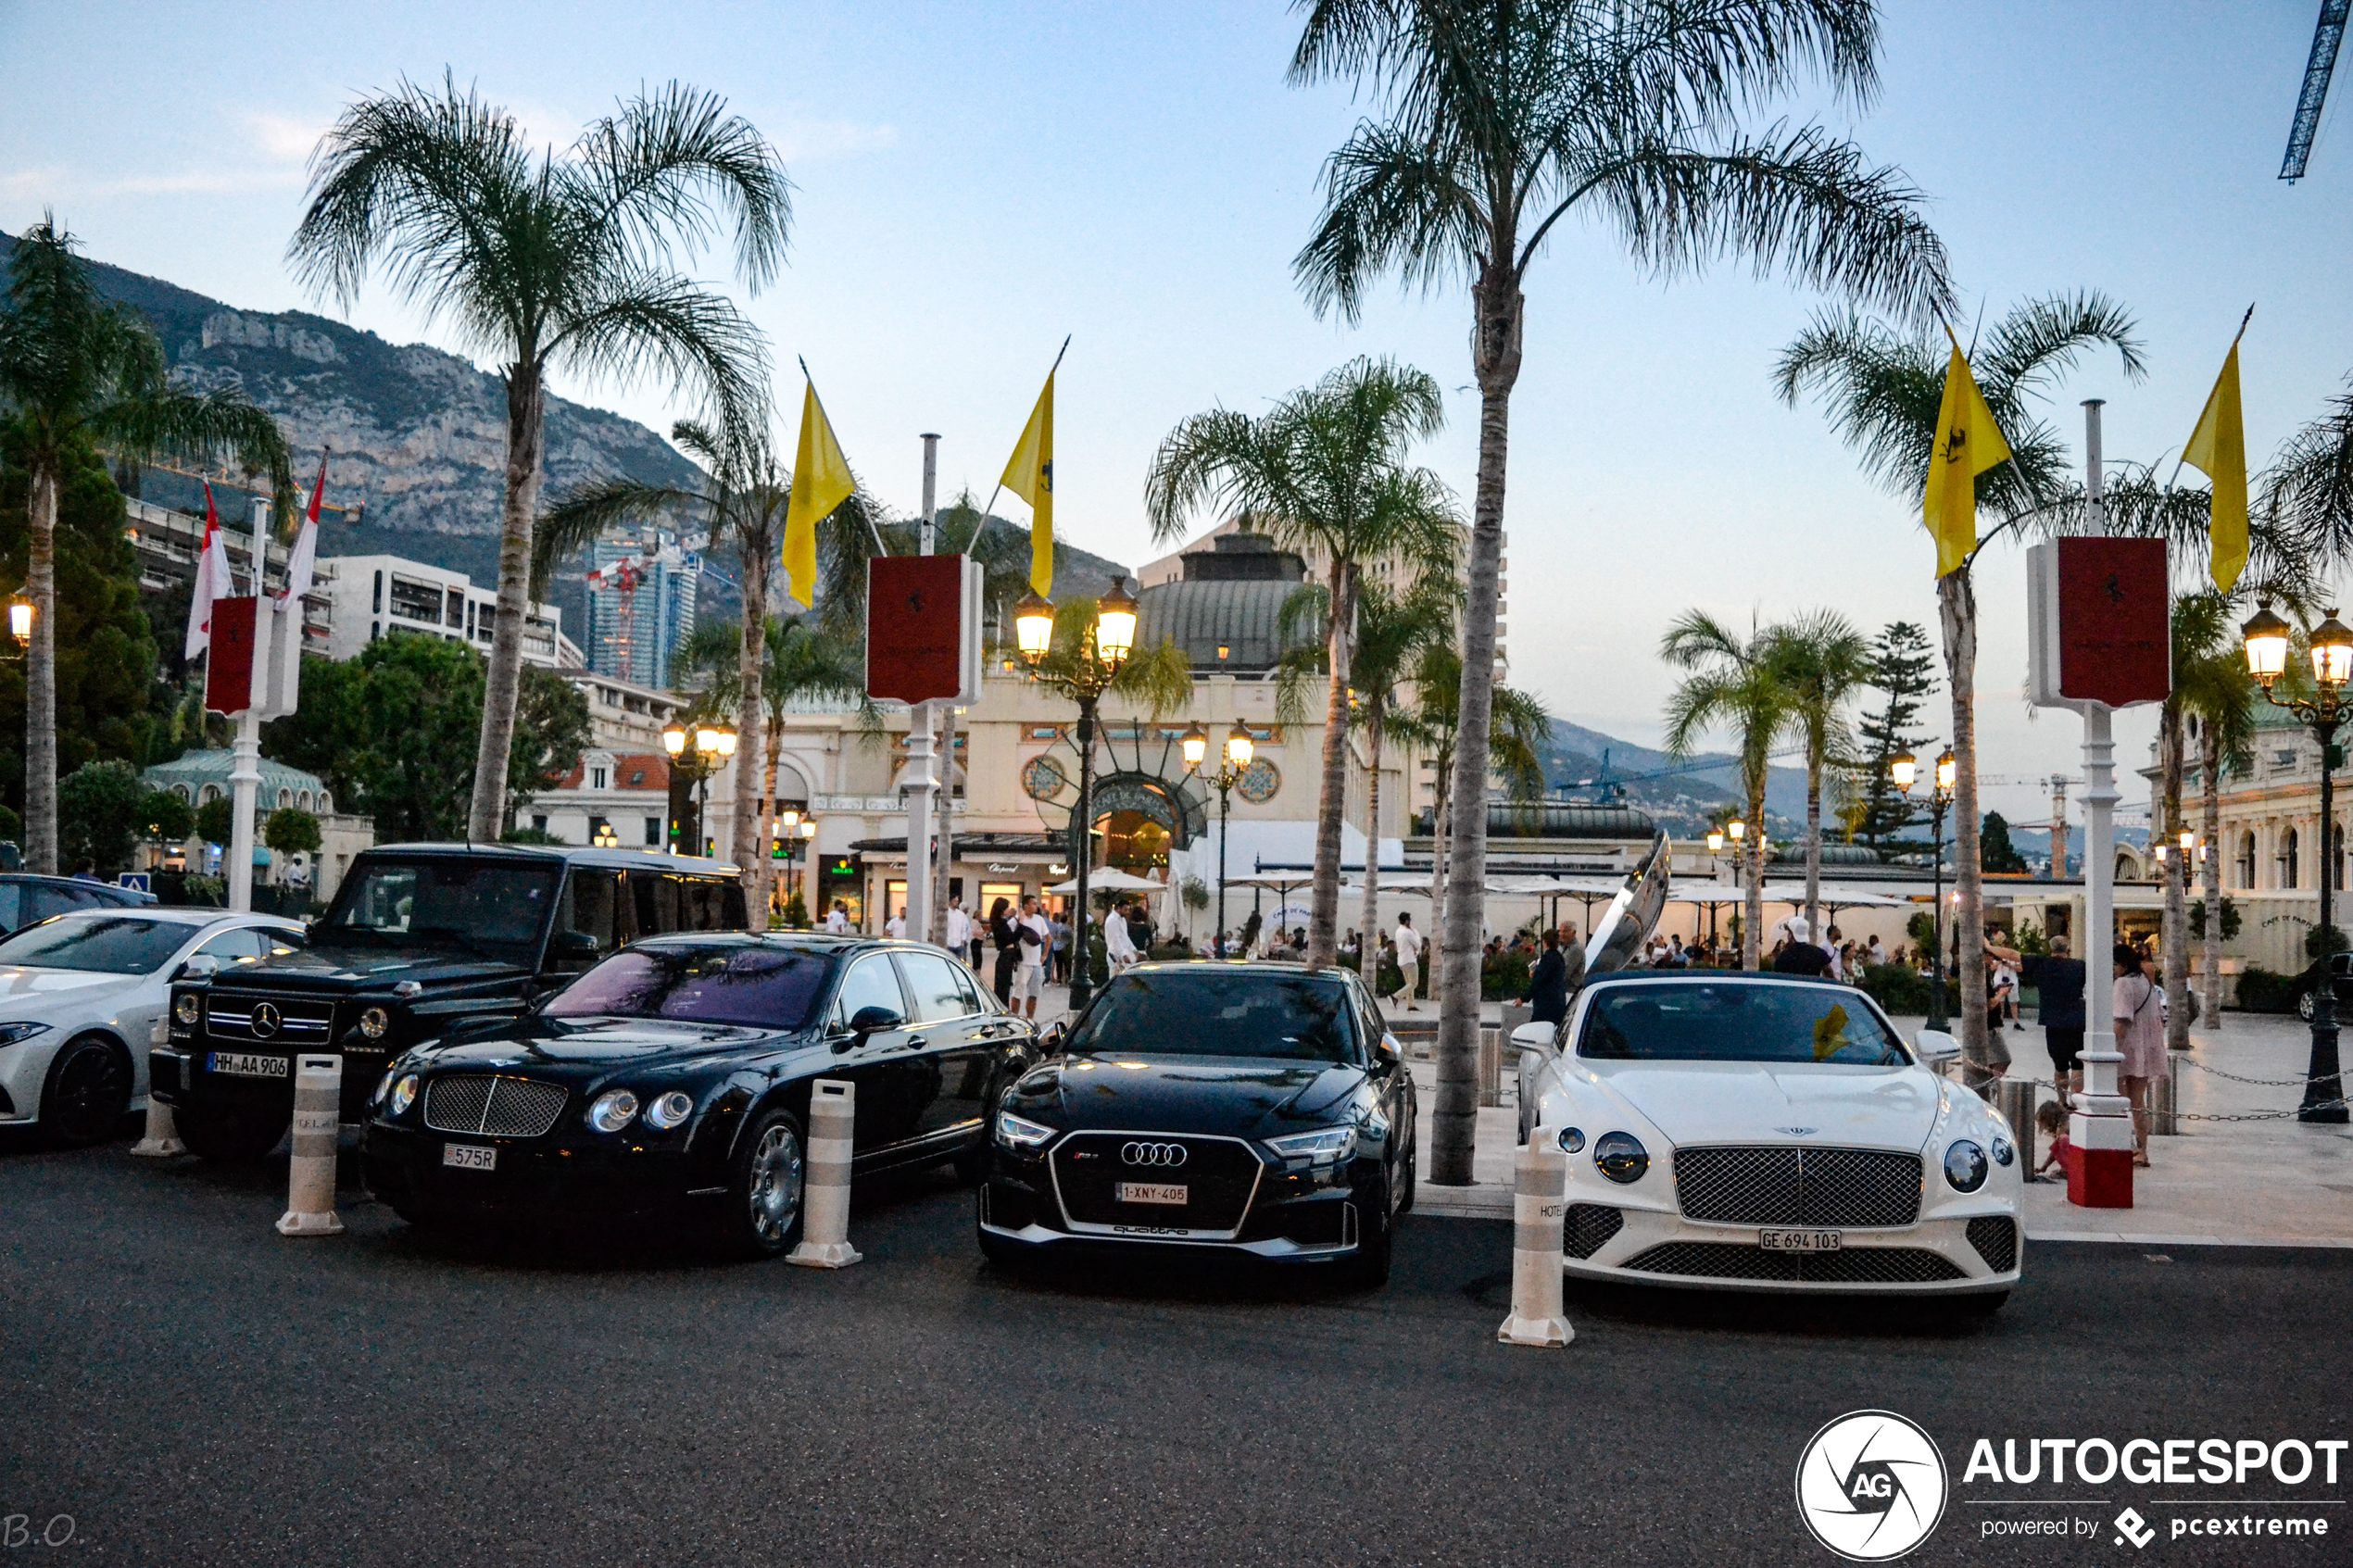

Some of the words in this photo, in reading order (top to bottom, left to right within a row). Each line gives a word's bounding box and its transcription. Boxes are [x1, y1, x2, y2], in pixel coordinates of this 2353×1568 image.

[988, 862, 1019, 873] Chopard
[215, 1054, 232, 1071] HH
[241, 1056, 258, 1073] AA
[261, 1059, 286, 1075] 906
[455, 1148, 493, 1167] 575R
[1124, 1185, 1185, 1200] 1-XNY-405
[1541, 1205, 1563, 1218] HOTEL
[1114, 1224, 1189, 1236] quattro
[1814, 1234, 1839, 1249] 103
